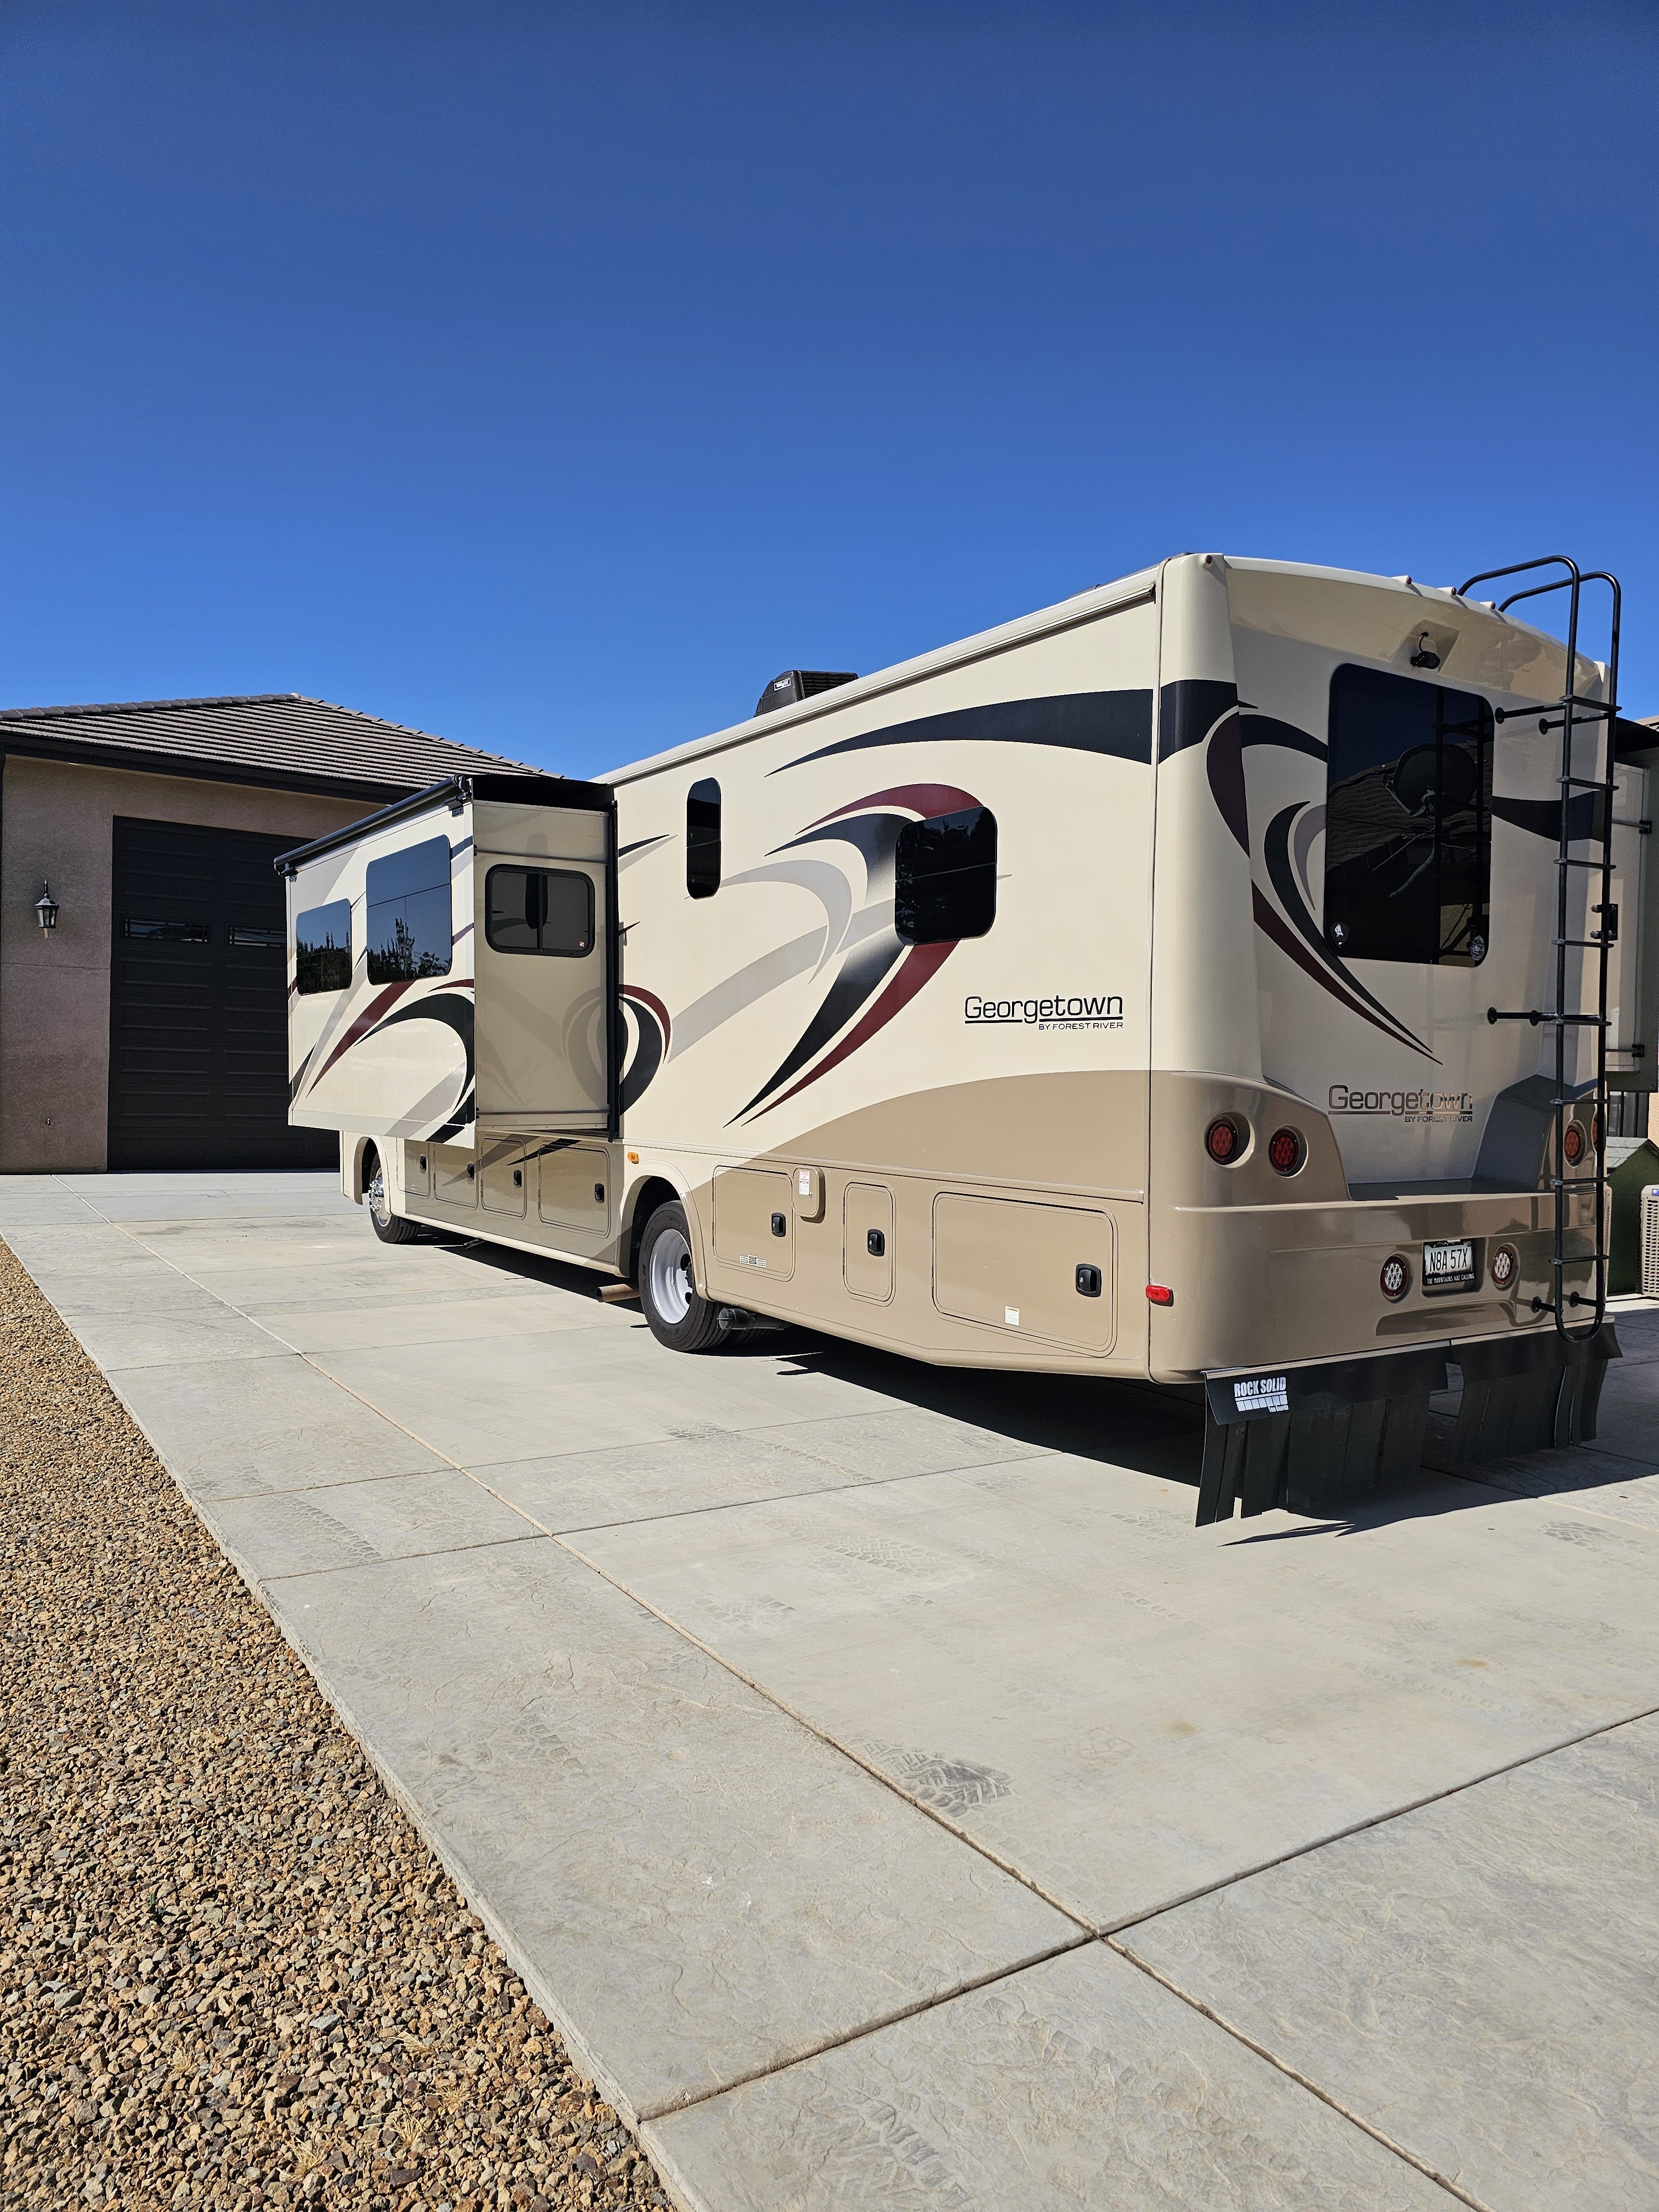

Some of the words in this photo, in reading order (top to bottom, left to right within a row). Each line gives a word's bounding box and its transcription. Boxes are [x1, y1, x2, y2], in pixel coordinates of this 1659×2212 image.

[965, 995, 1123, 1024] Georgetown
[1328, 1084, 1473, 1116] Georgetown
[1430, 1251, 1447, 1272] N8A
[1451, 1248, 1468, 1269] 57X
[1234, 1380, 1259, 1397] ROCK
[1260, 1376, 1286, 1394] SOLID
